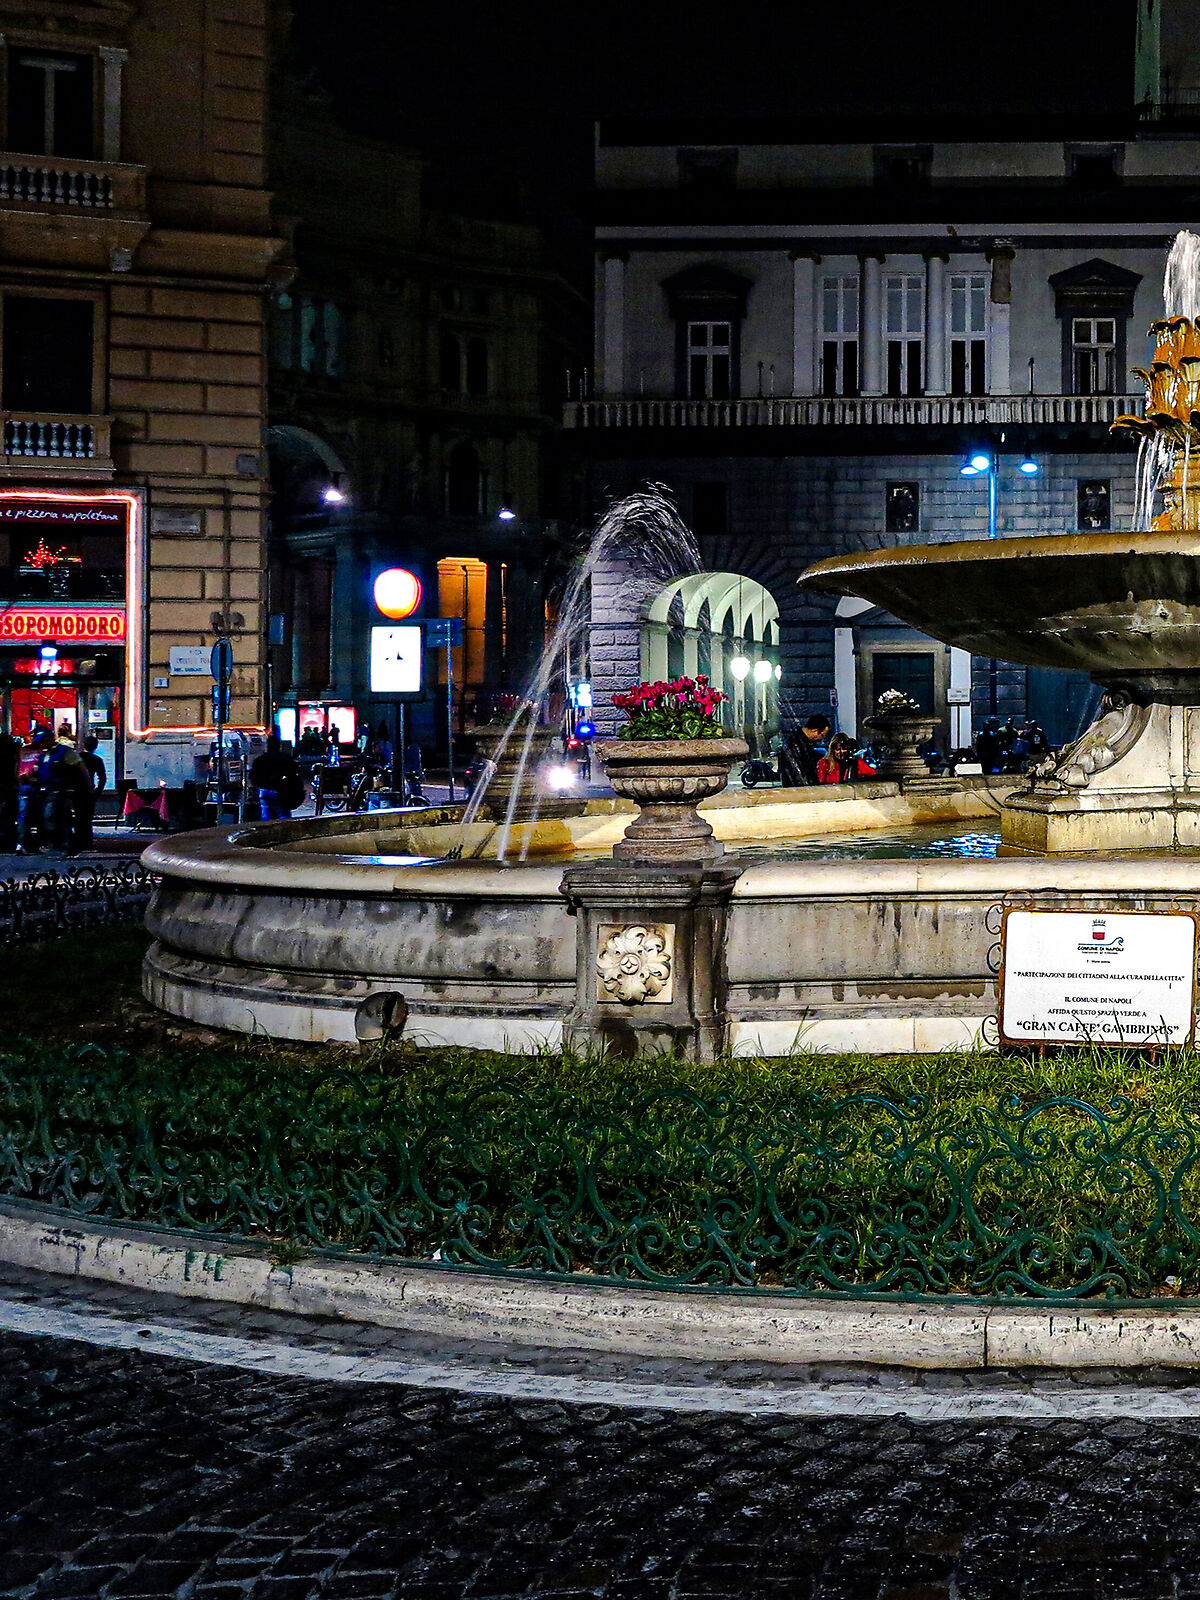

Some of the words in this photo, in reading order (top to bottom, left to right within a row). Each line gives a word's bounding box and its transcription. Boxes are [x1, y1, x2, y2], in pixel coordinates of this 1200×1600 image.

[14, 509, 58, 520] pizzeria
[62, 509, 119, 521] napoletana
[0, 615, 120, 635] SOPOMODORO
